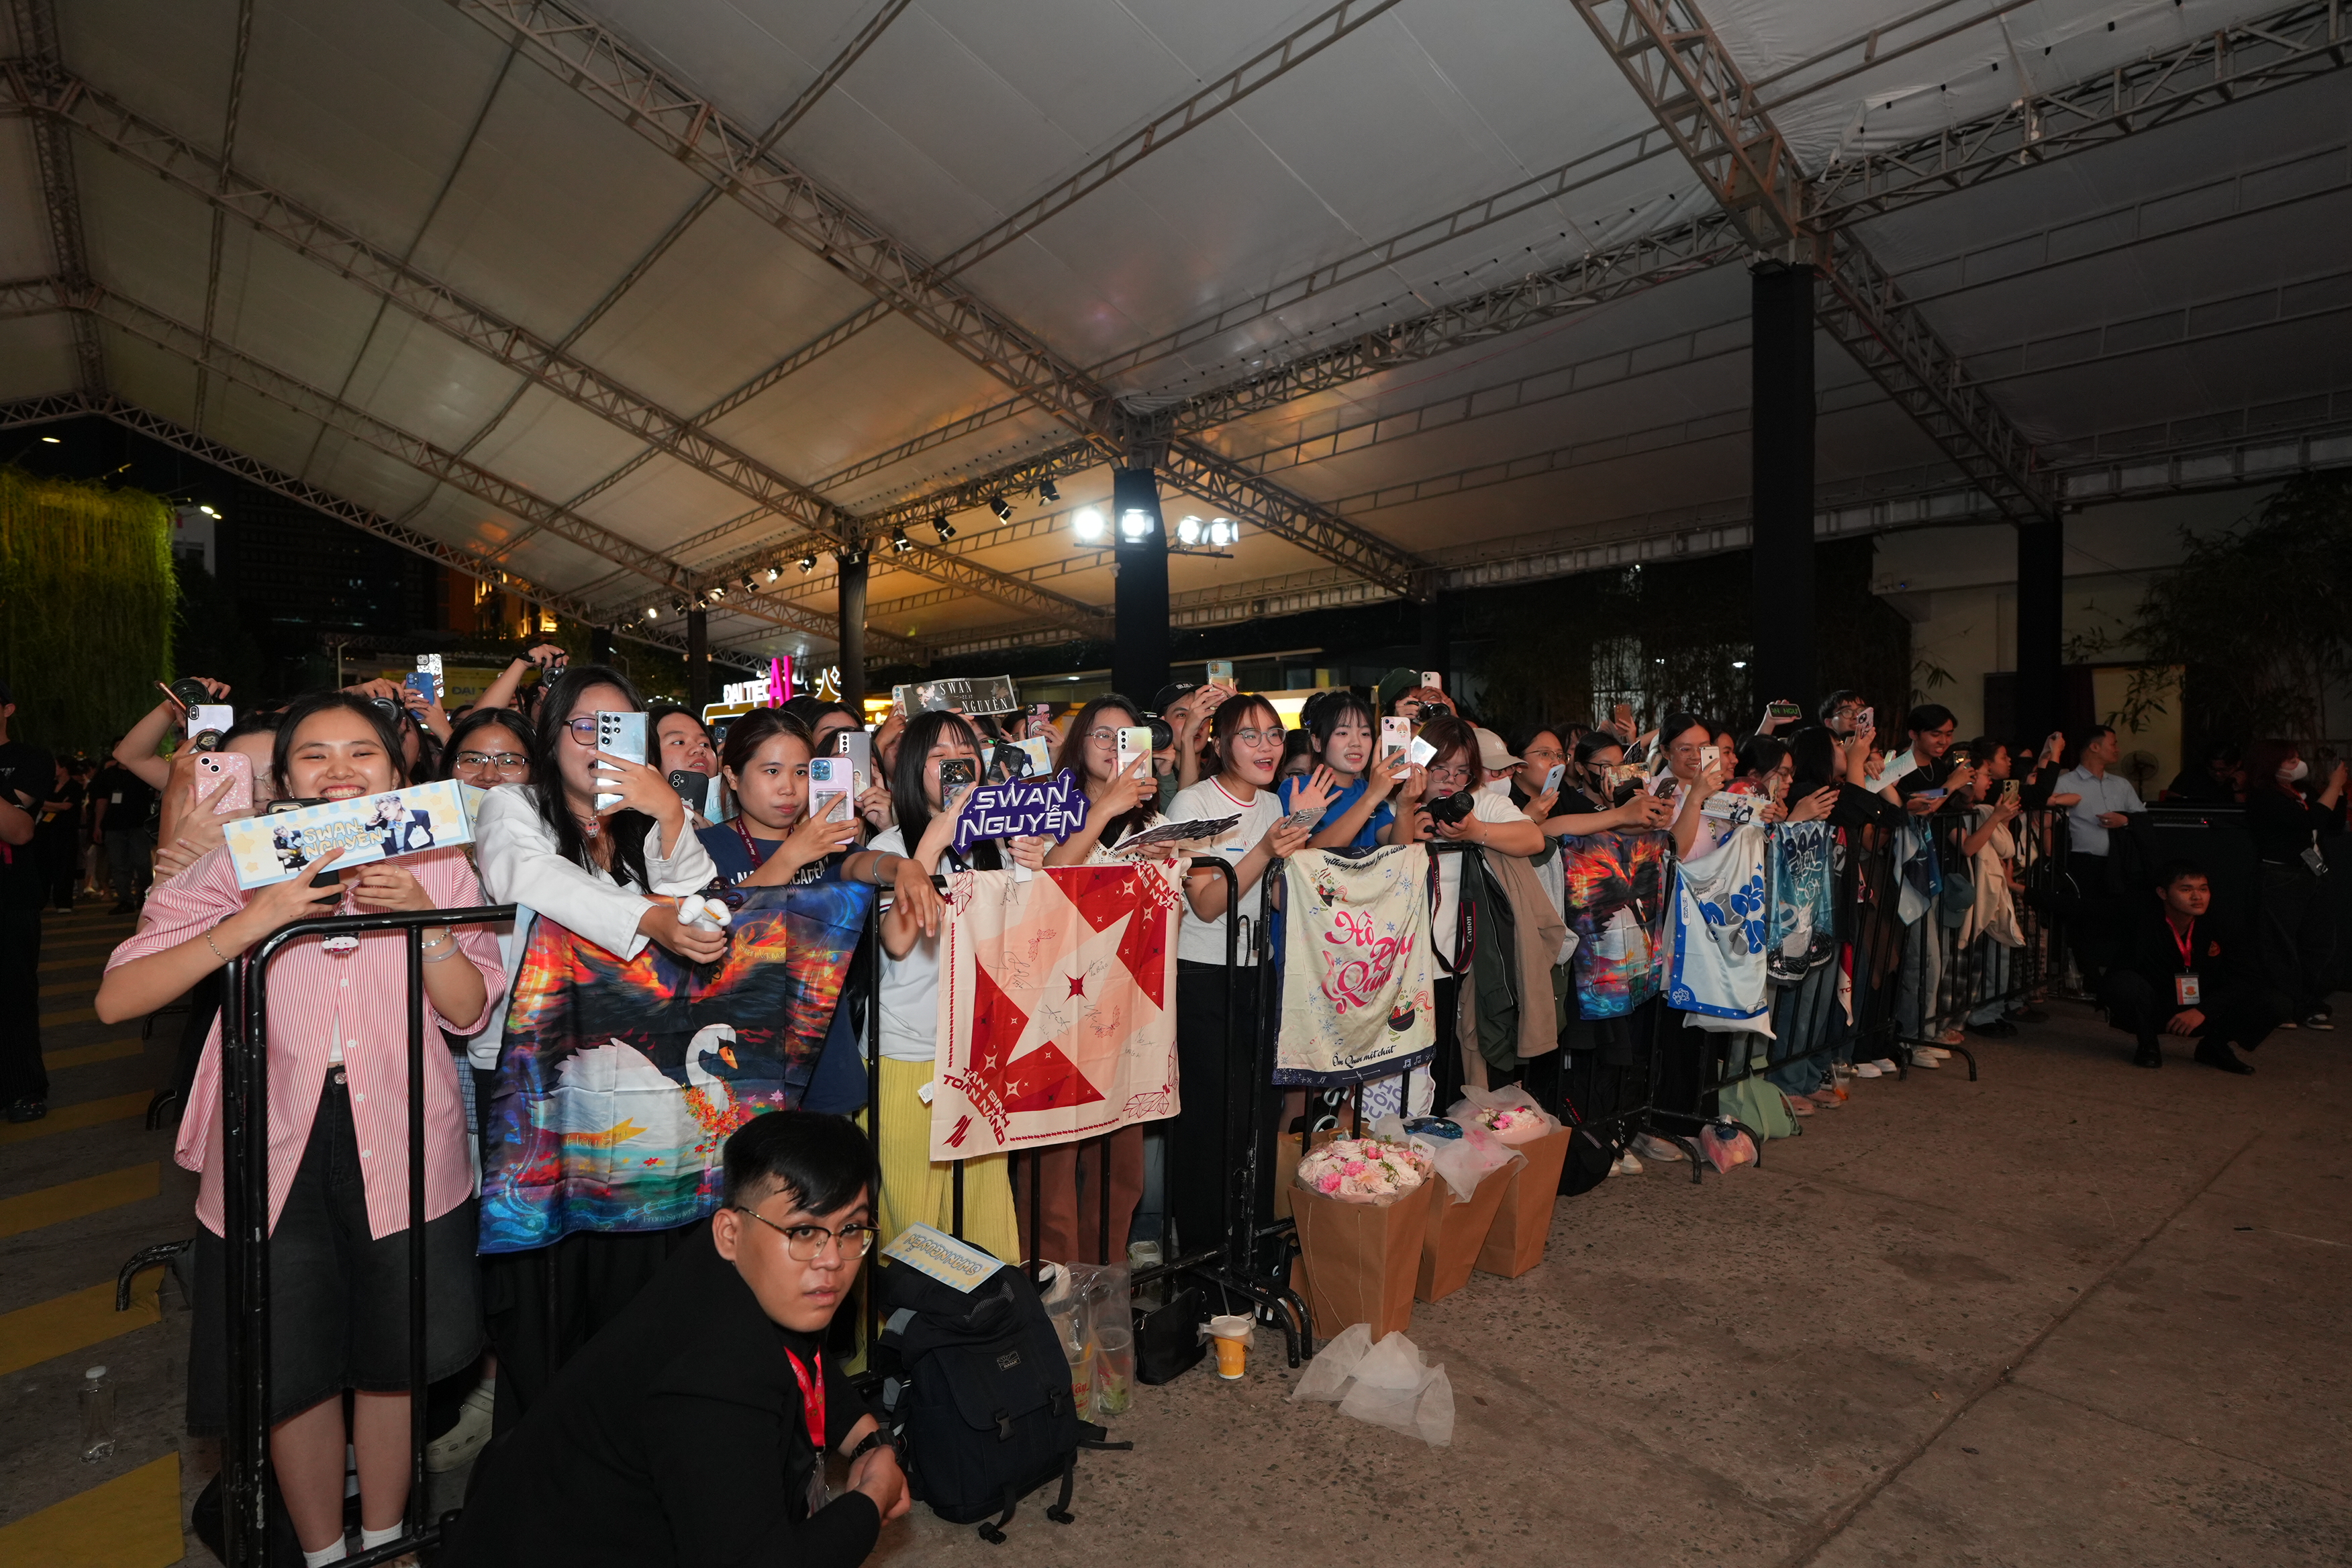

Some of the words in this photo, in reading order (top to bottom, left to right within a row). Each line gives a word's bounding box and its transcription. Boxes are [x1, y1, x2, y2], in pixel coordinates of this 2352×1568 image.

[769, 655, 794, 708] AI
[940, 681, 971, 695] SWAN
[962, 696, 1008, 713] NGUYỄN
[973, 773, 1071, 812] SWAN
[303, 818, 359, 844] SWAN
[958, 798, 1085, 849] NGUYỄN
[739, 943, 756, 959] Swan
[1332, 1052, 1344, 1067] Ôm
[1377, 1044, 1397, 1057] chút
[943, 1074, 981, 1101] TOÀN
[963, 1067, 989, 1091] TÂN
[643, 1214, 665, 1223] From
